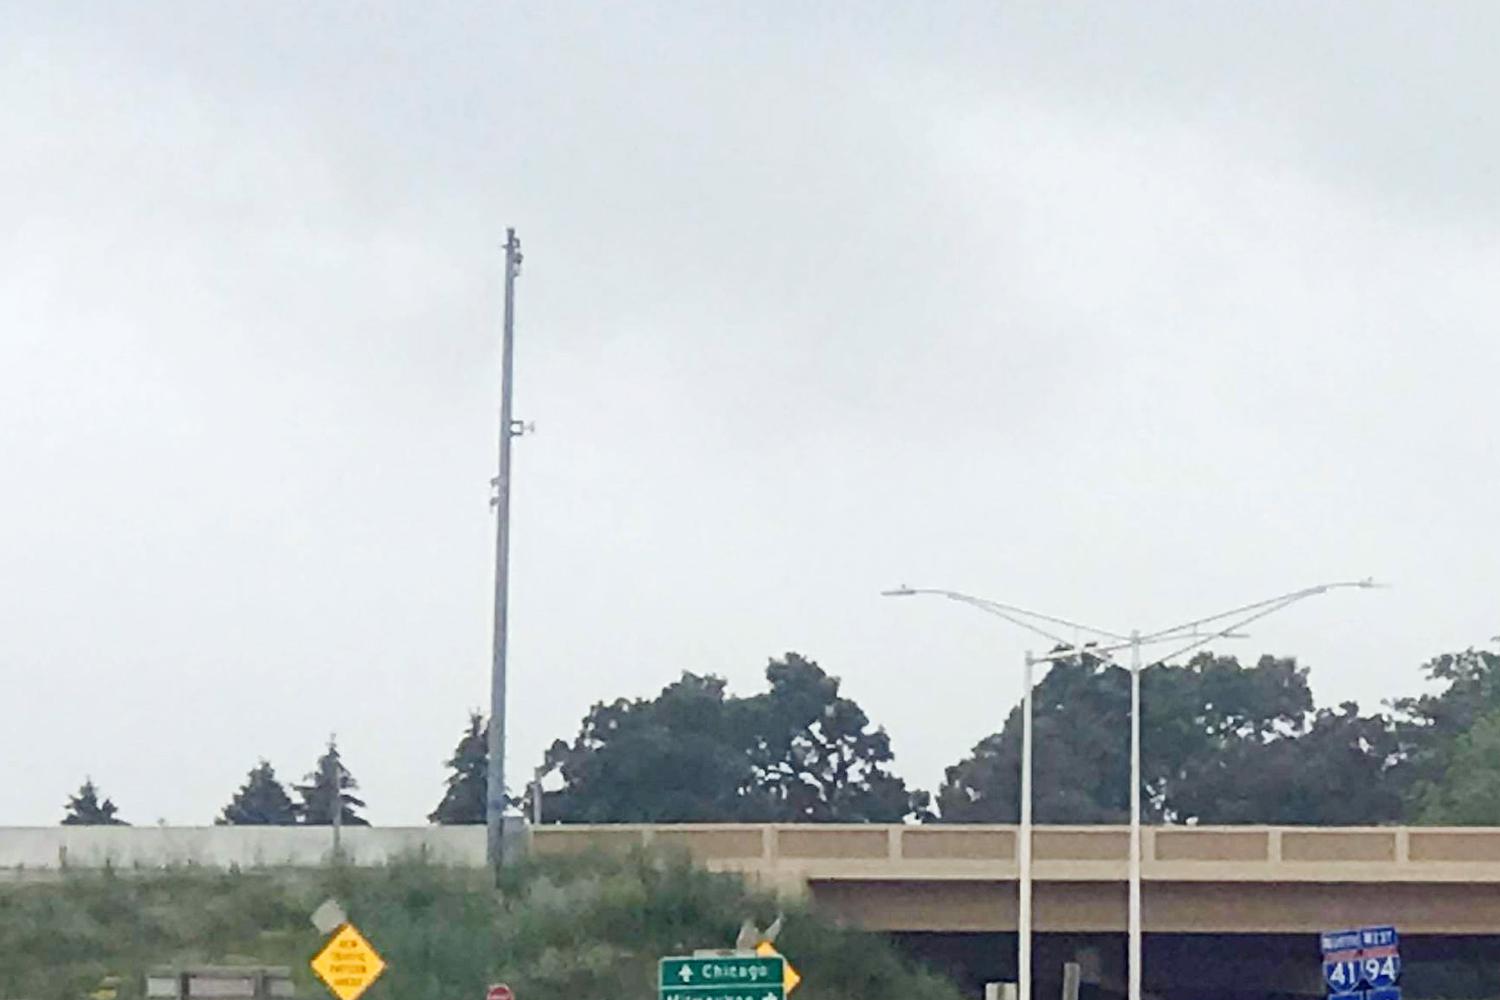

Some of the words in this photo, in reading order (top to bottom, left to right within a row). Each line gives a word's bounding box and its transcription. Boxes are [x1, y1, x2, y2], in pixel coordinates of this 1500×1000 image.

[702, 963, 768, 981] Chicago
[1330, 963, 1355, 985] 41
[1365, 957, 1396, 981] 94
